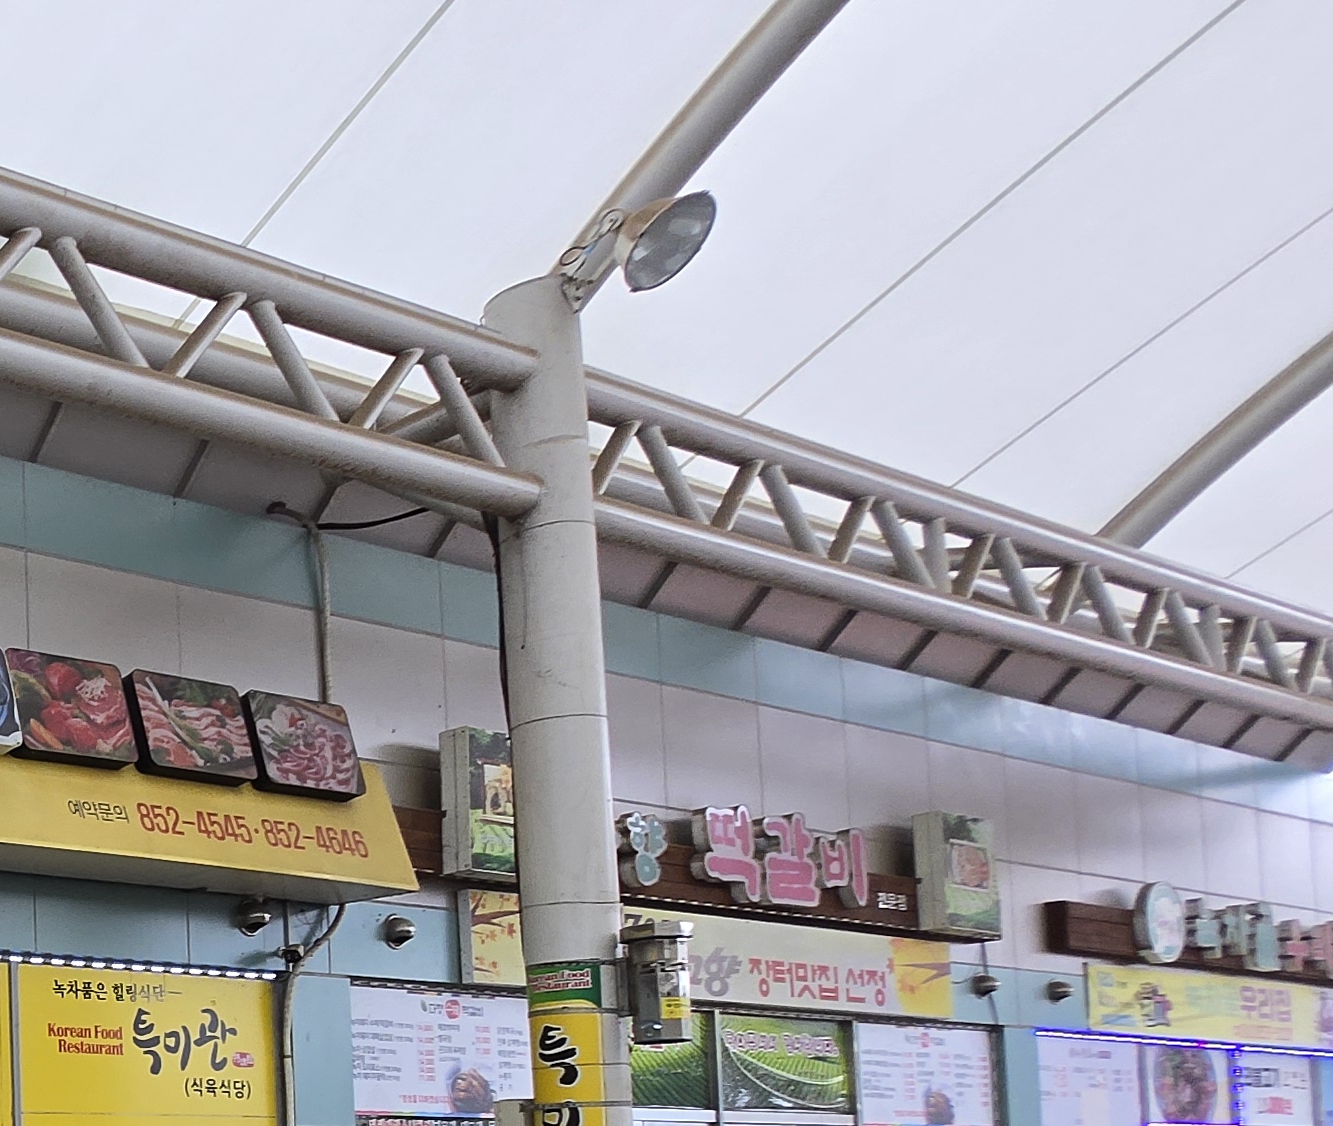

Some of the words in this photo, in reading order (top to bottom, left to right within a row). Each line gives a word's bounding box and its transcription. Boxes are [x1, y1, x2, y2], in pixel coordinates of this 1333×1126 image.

[67, 799, 130, 824] 예약문의
[704, 804, 869, 907] 떡갈비
[52, 978, 108, 1000] 녹차품은
[748, 957, 840, 1002] 장터맛집
[846, 967, 887, 1007] 선정
[47, 1022, 92, 1039] Korean
[94, 1025, 123, 1041] Food
[132, 1007, 238, 1076] 특미관
[58, 1039, 124, 1056] Restaurant
[184, 1077, 252, 1101] (식육식당)
